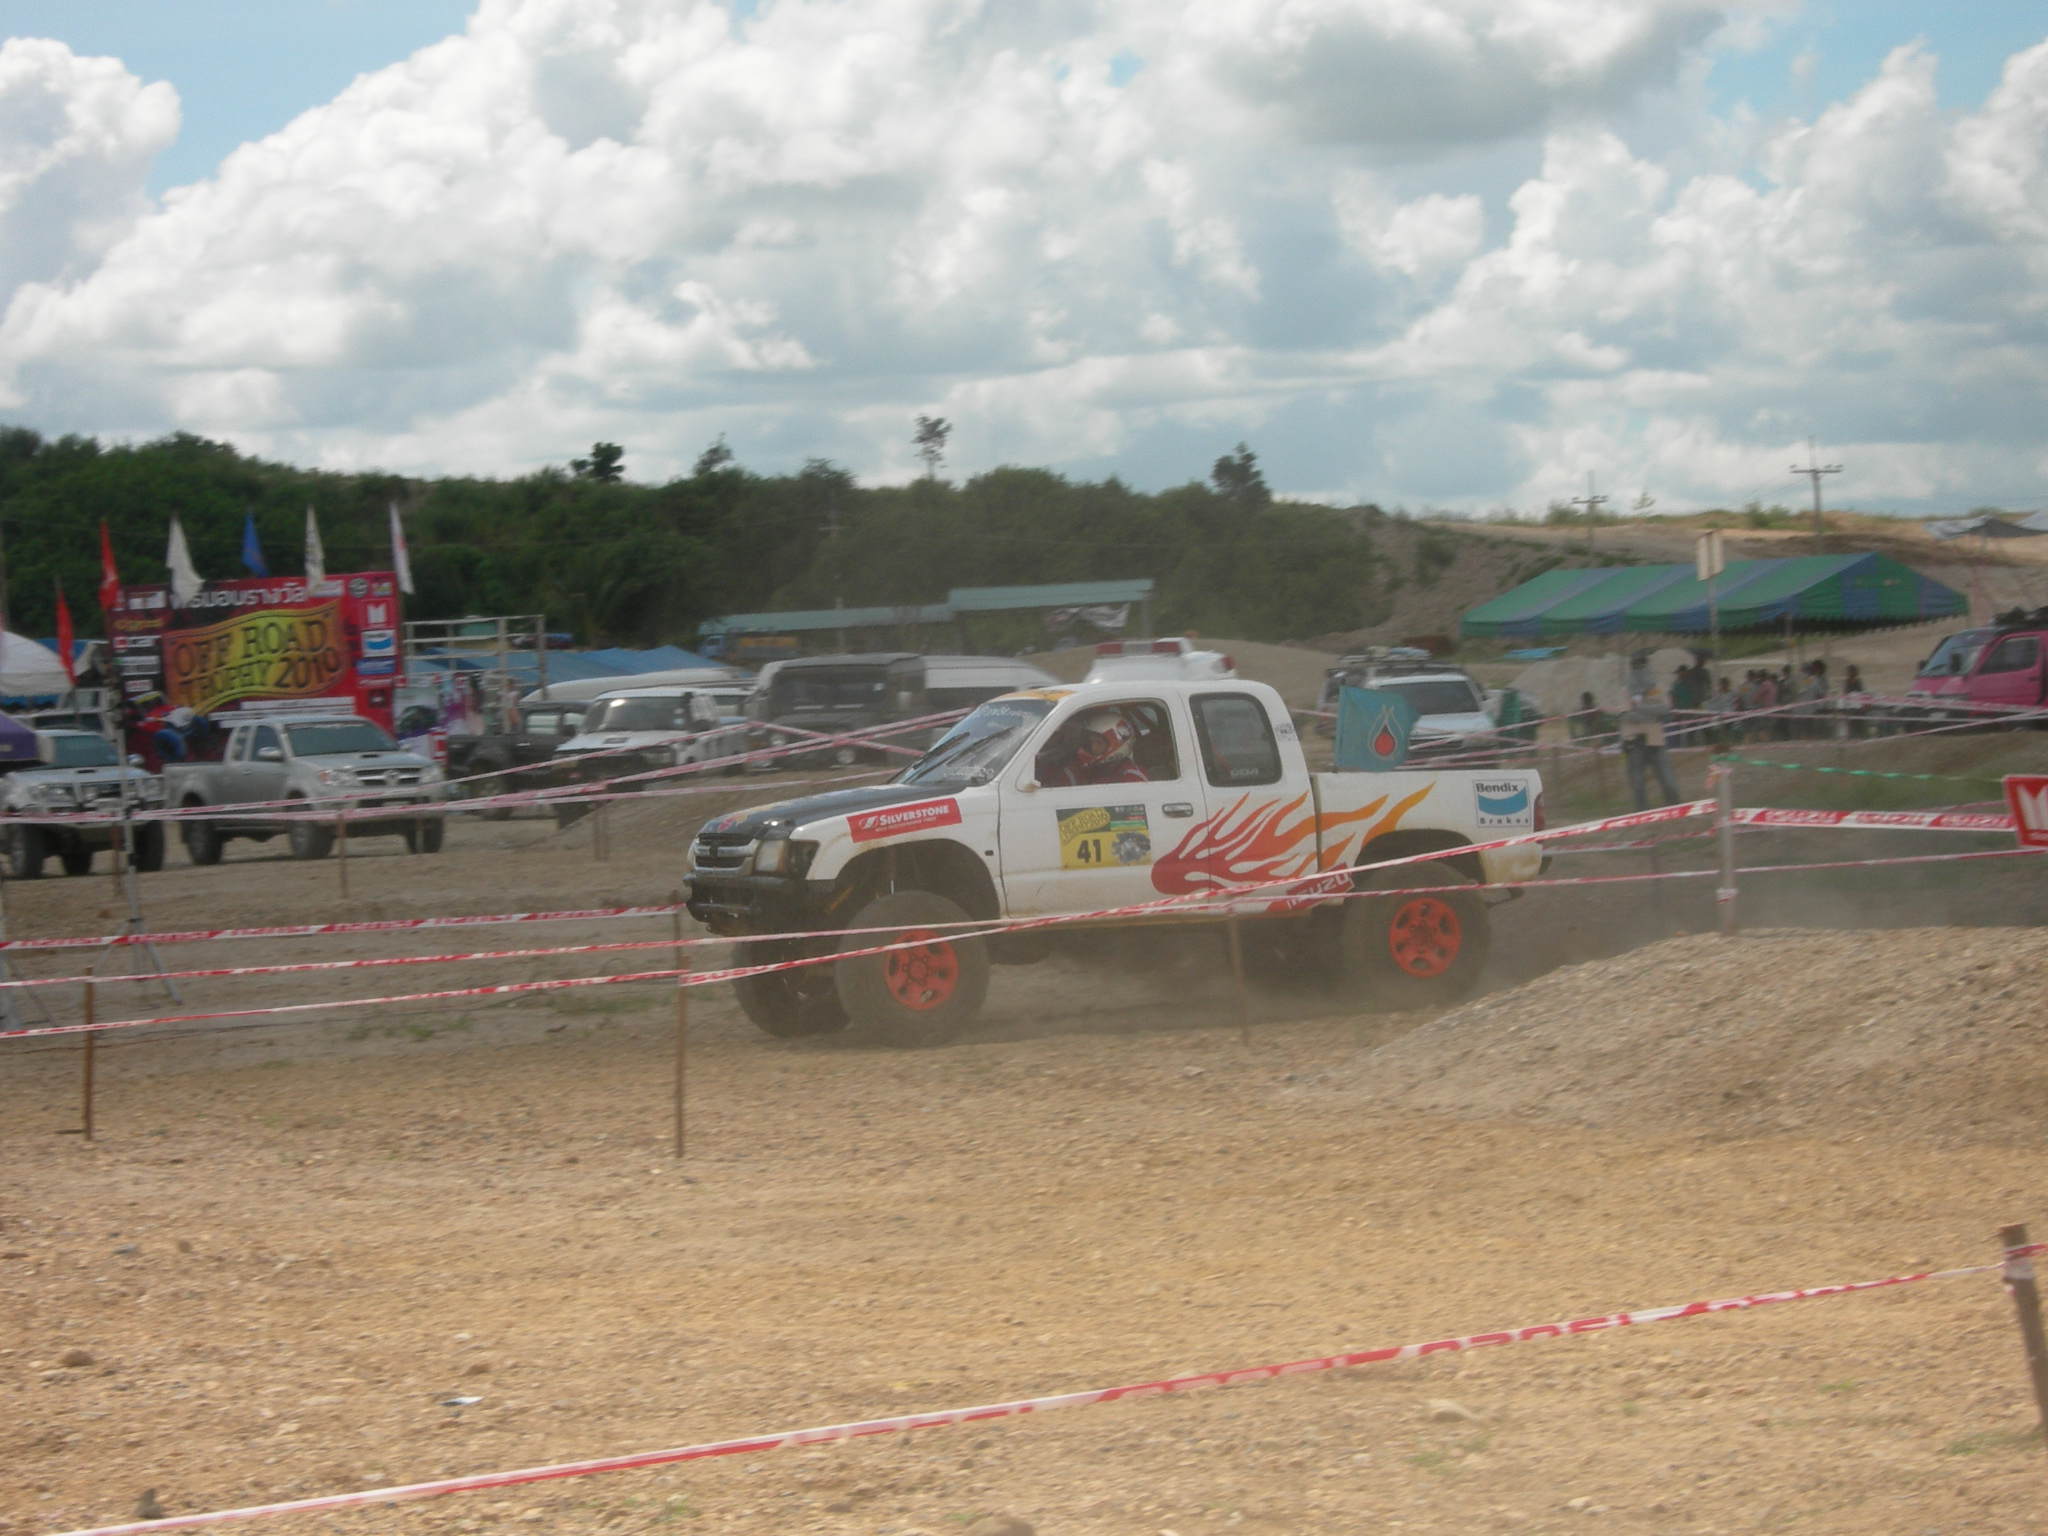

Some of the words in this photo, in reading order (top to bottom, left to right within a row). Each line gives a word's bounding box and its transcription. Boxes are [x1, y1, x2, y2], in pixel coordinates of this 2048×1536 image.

[174, 633, 232, 677] OFF
[242, 620, 327, 659] ROAD
[179, 660, 271, 708] TROPHY
[275, 647, 341, 688] 2010
[1475, 782, 1519, 793] Bendix
[879, 805, 950, 826] SILVERSTONE
[1479, 817, 1529, 825] Brakes
[1077, 839, 1102, 863] 41
[1286, 871, 1351, 910] IUZU
